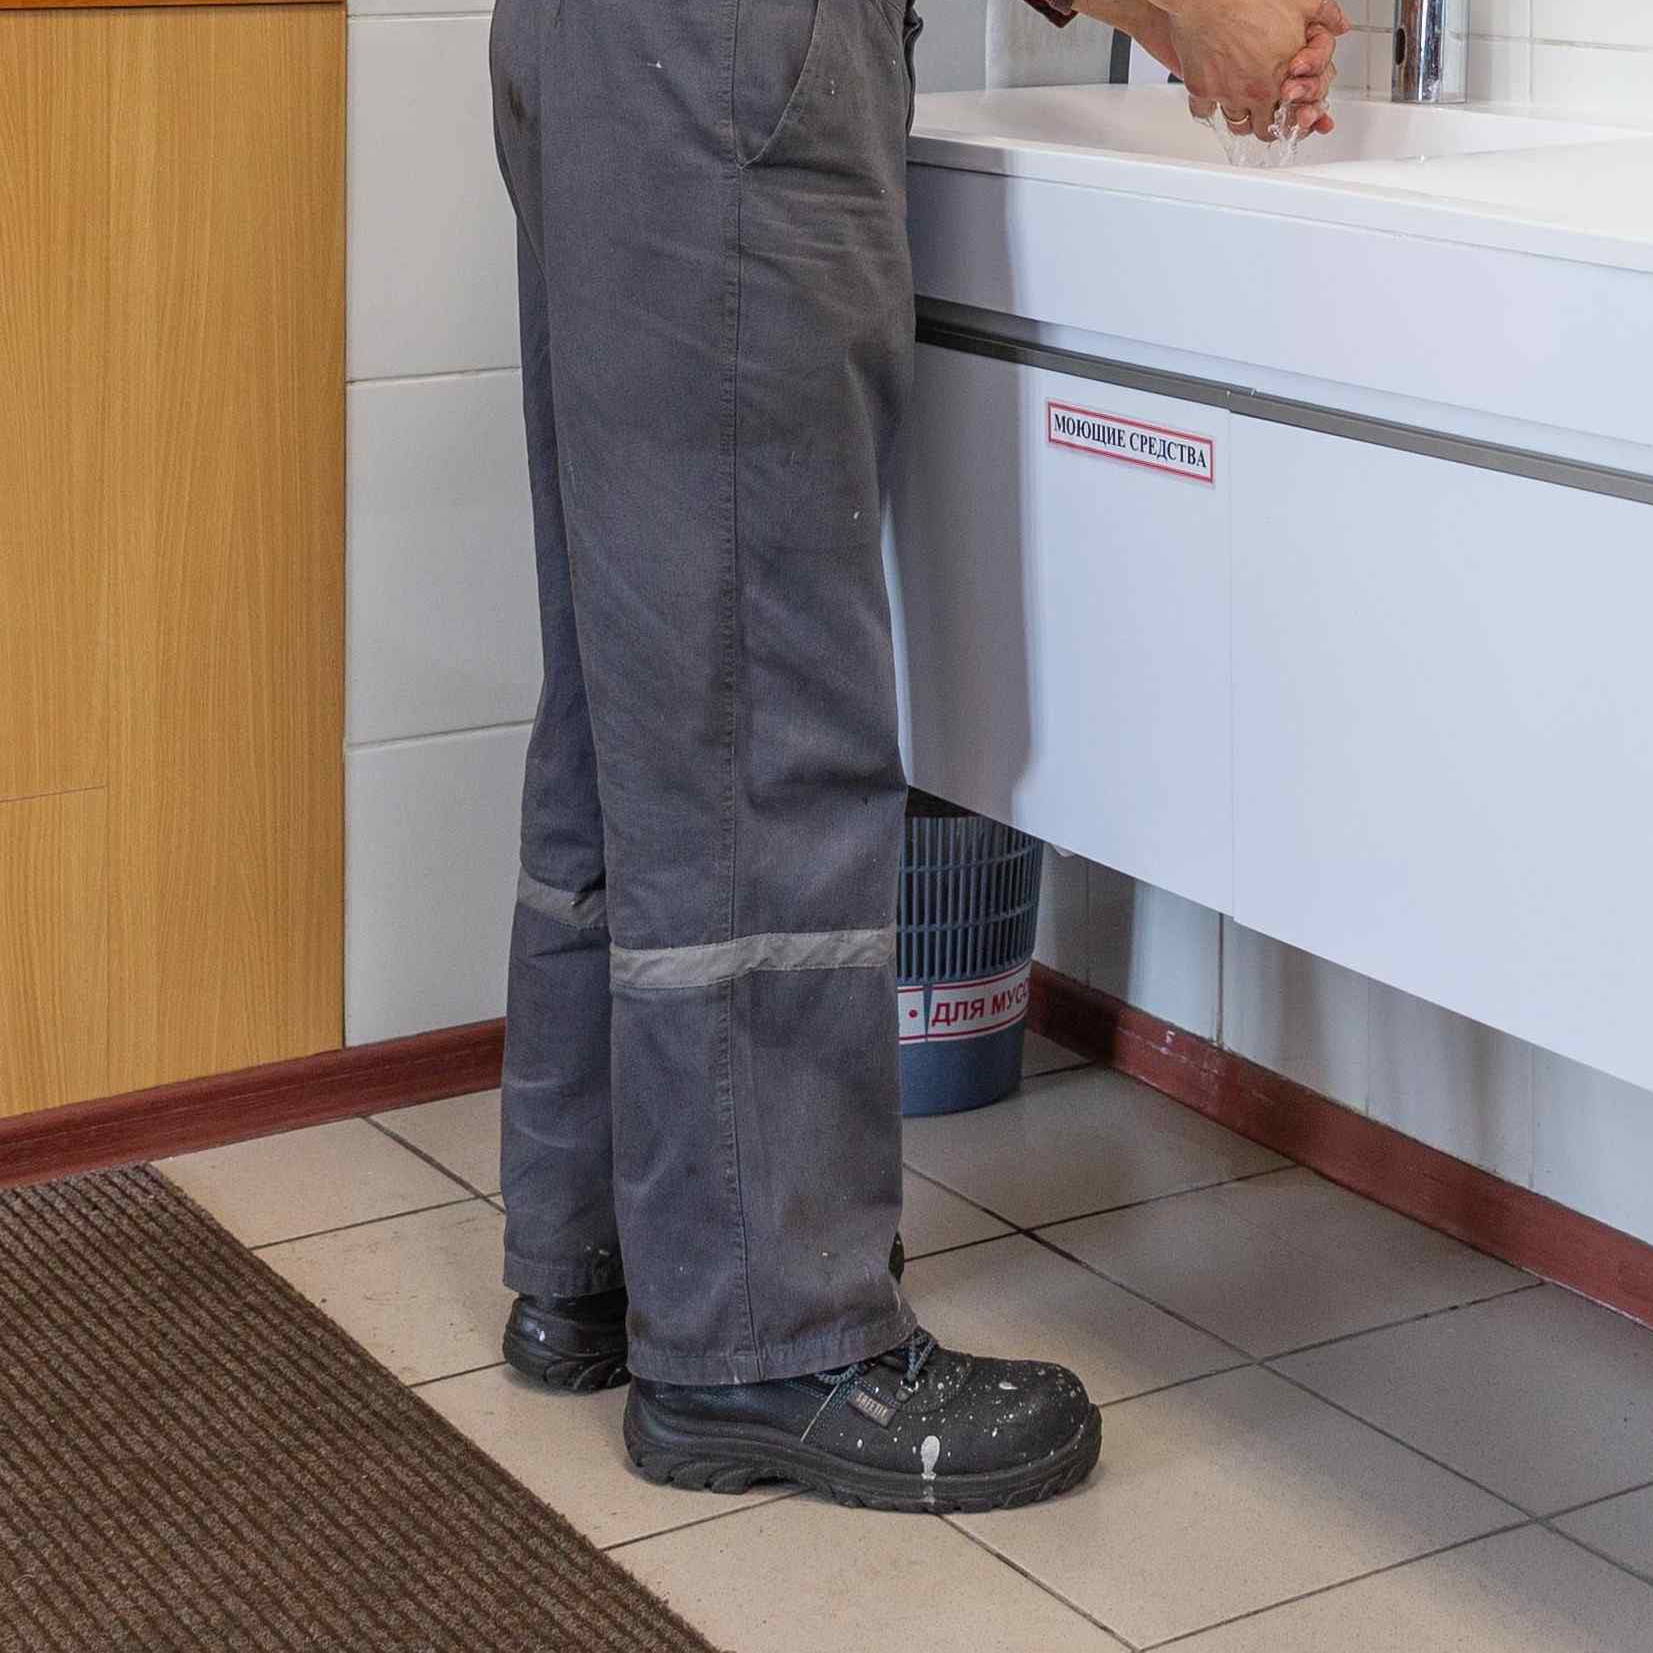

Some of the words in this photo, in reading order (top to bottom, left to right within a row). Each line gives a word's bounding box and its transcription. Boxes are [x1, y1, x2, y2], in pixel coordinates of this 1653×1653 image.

[1054, 413, 1126, 448] МОЮЩИЕ
[1129, 432, 1208, 468] СРЕДСТВА
[932, 998, 984, 1026] ДЛЯ
